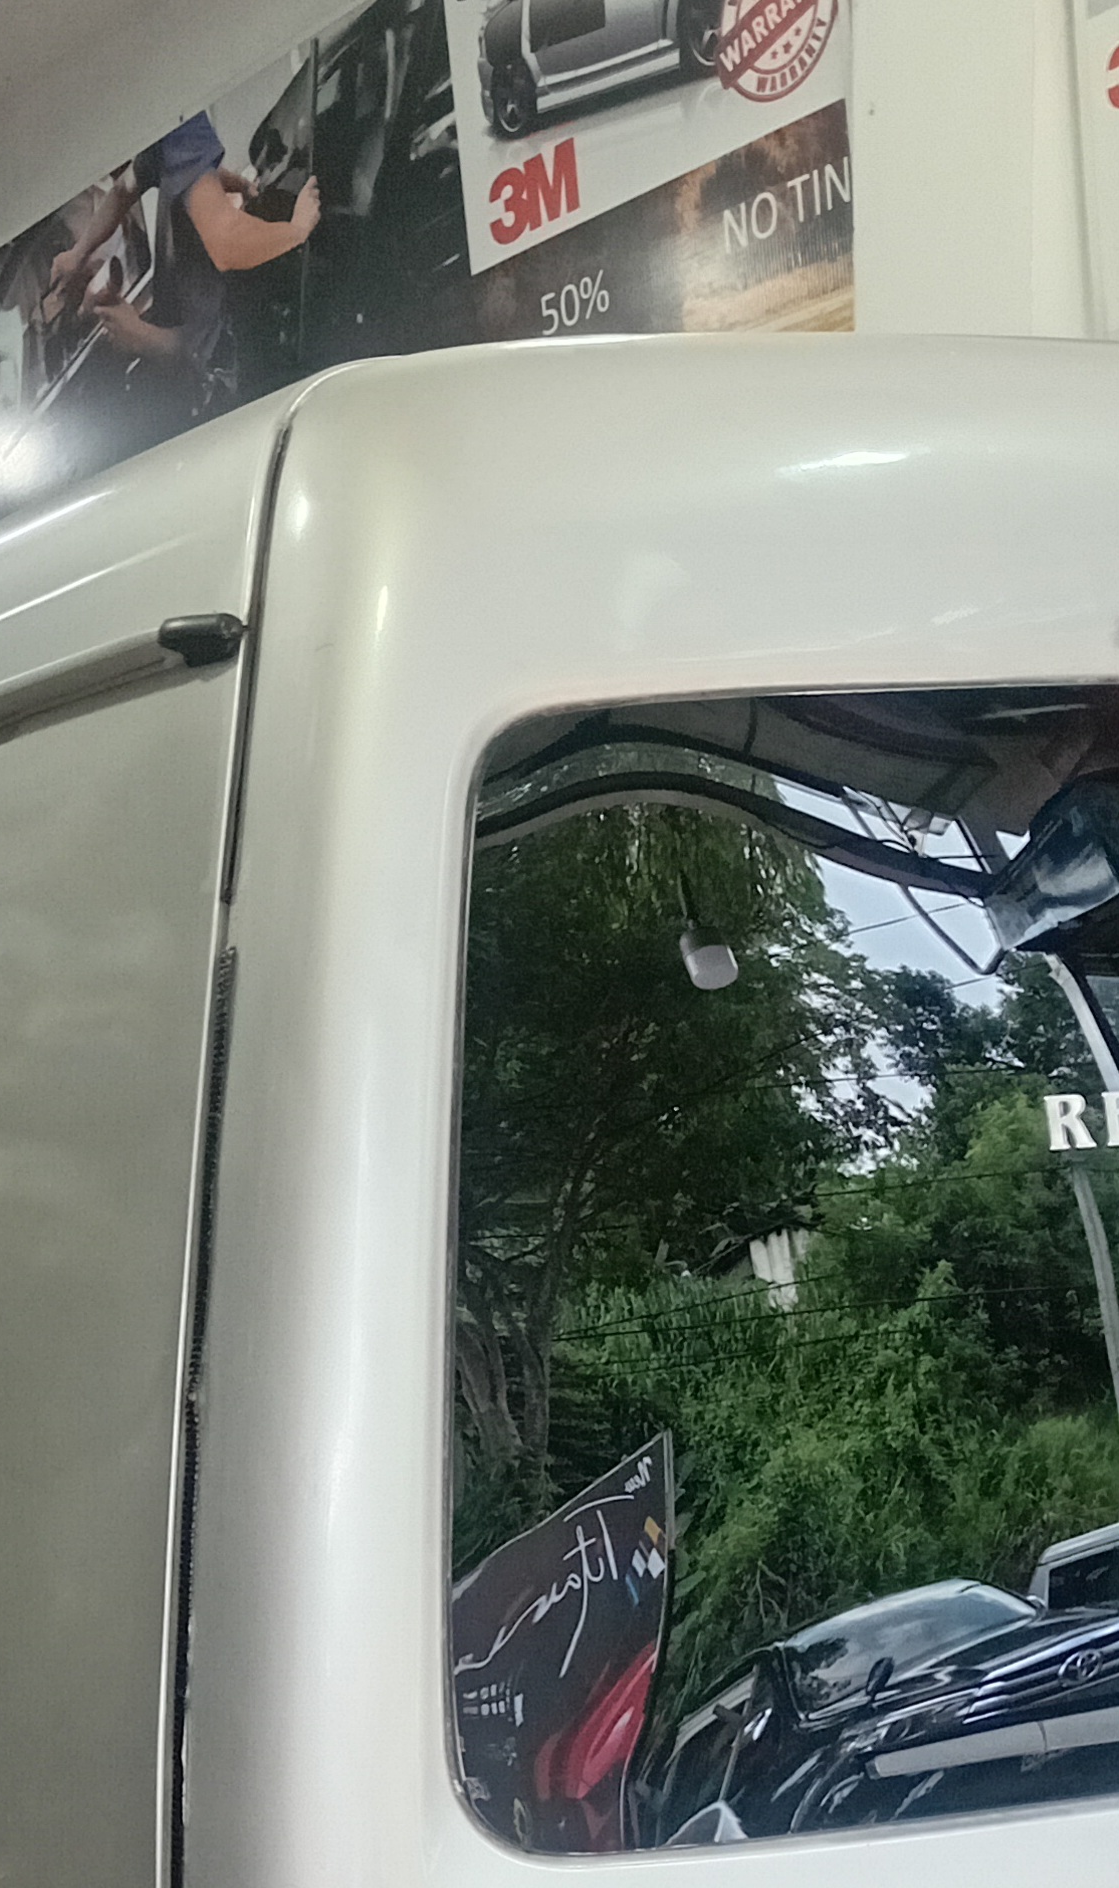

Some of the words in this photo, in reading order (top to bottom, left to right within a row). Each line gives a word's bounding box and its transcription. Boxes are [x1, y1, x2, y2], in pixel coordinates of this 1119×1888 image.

[719, 0, 801, 72] WARRA
[488, 137, 580, 245] 3M
[723, 190, 778, 255] NO
[787, 155, 852, 223] TIN
[540, 269, 610, 336] 50%
